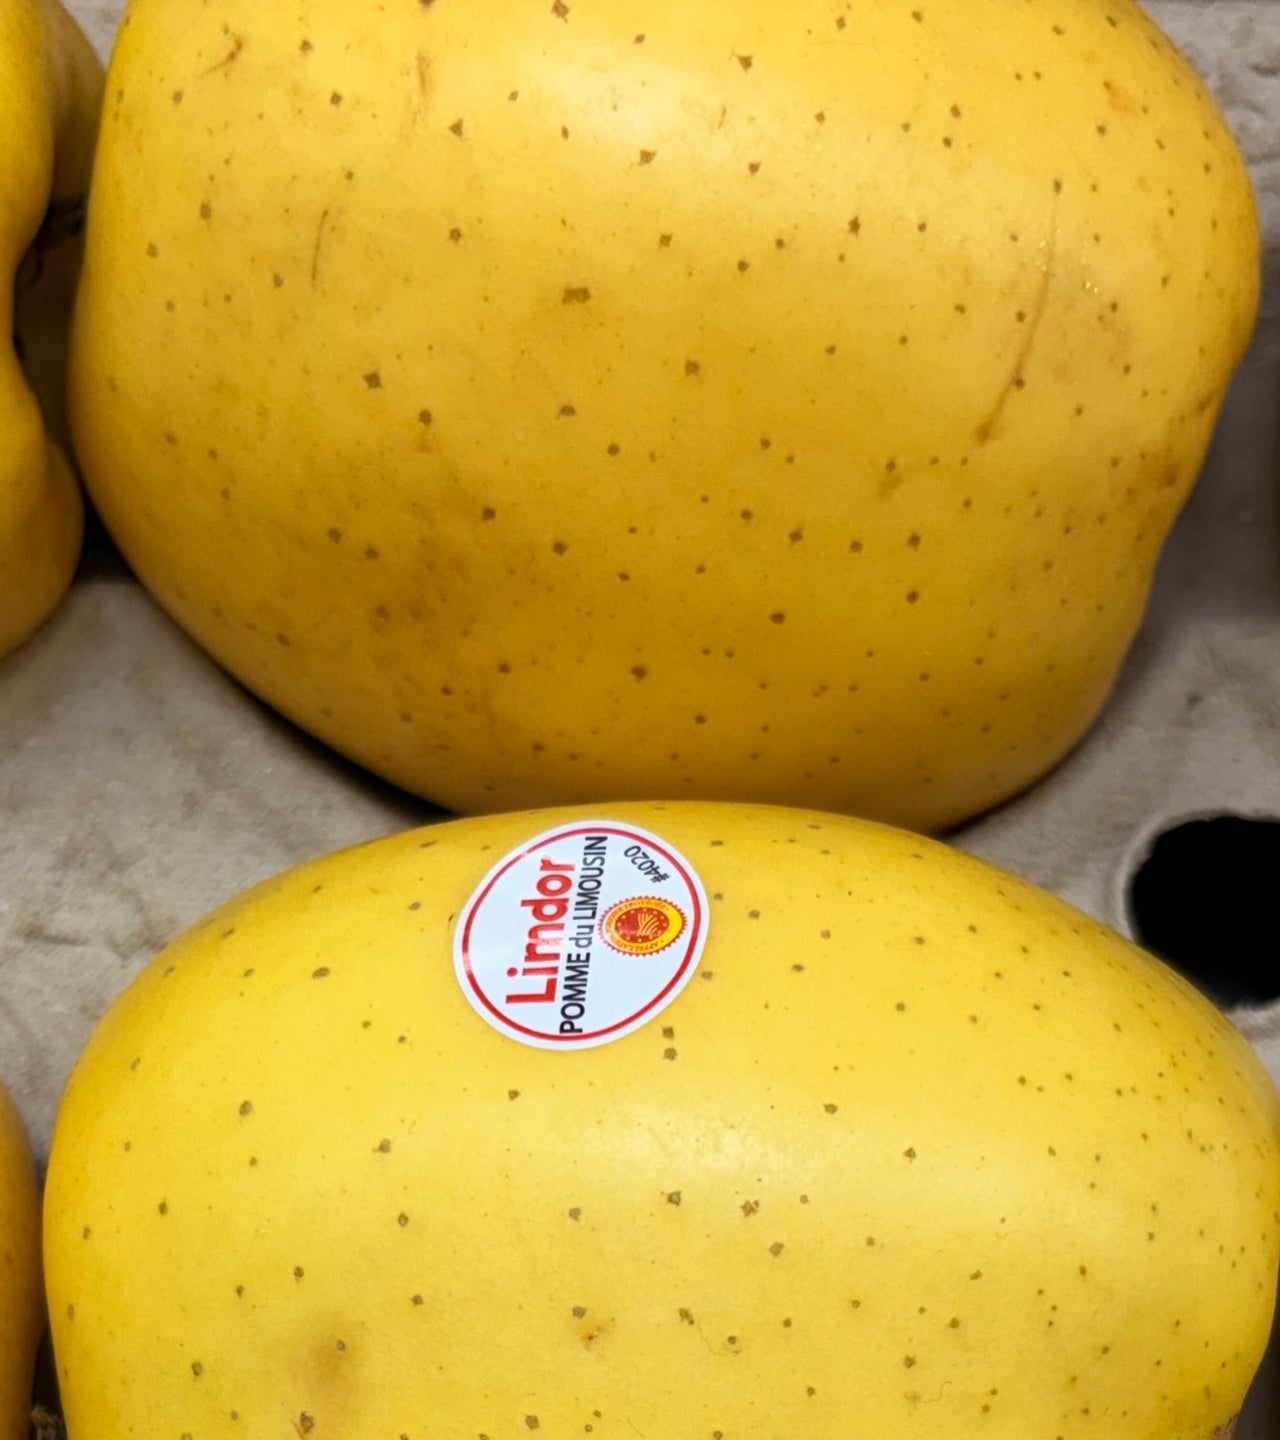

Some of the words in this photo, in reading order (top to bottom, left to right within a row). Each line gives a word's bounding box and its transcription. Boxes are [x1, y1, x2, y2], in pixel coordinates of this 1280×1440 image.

[572, 836, 608, 920] LIMOUSIN
[624, 845, 670, 883] #4020
[505, 854, 575, 1004] Limdor
[569, 925, 594, 948] du
[559, 952, 591, 1034] POMME
